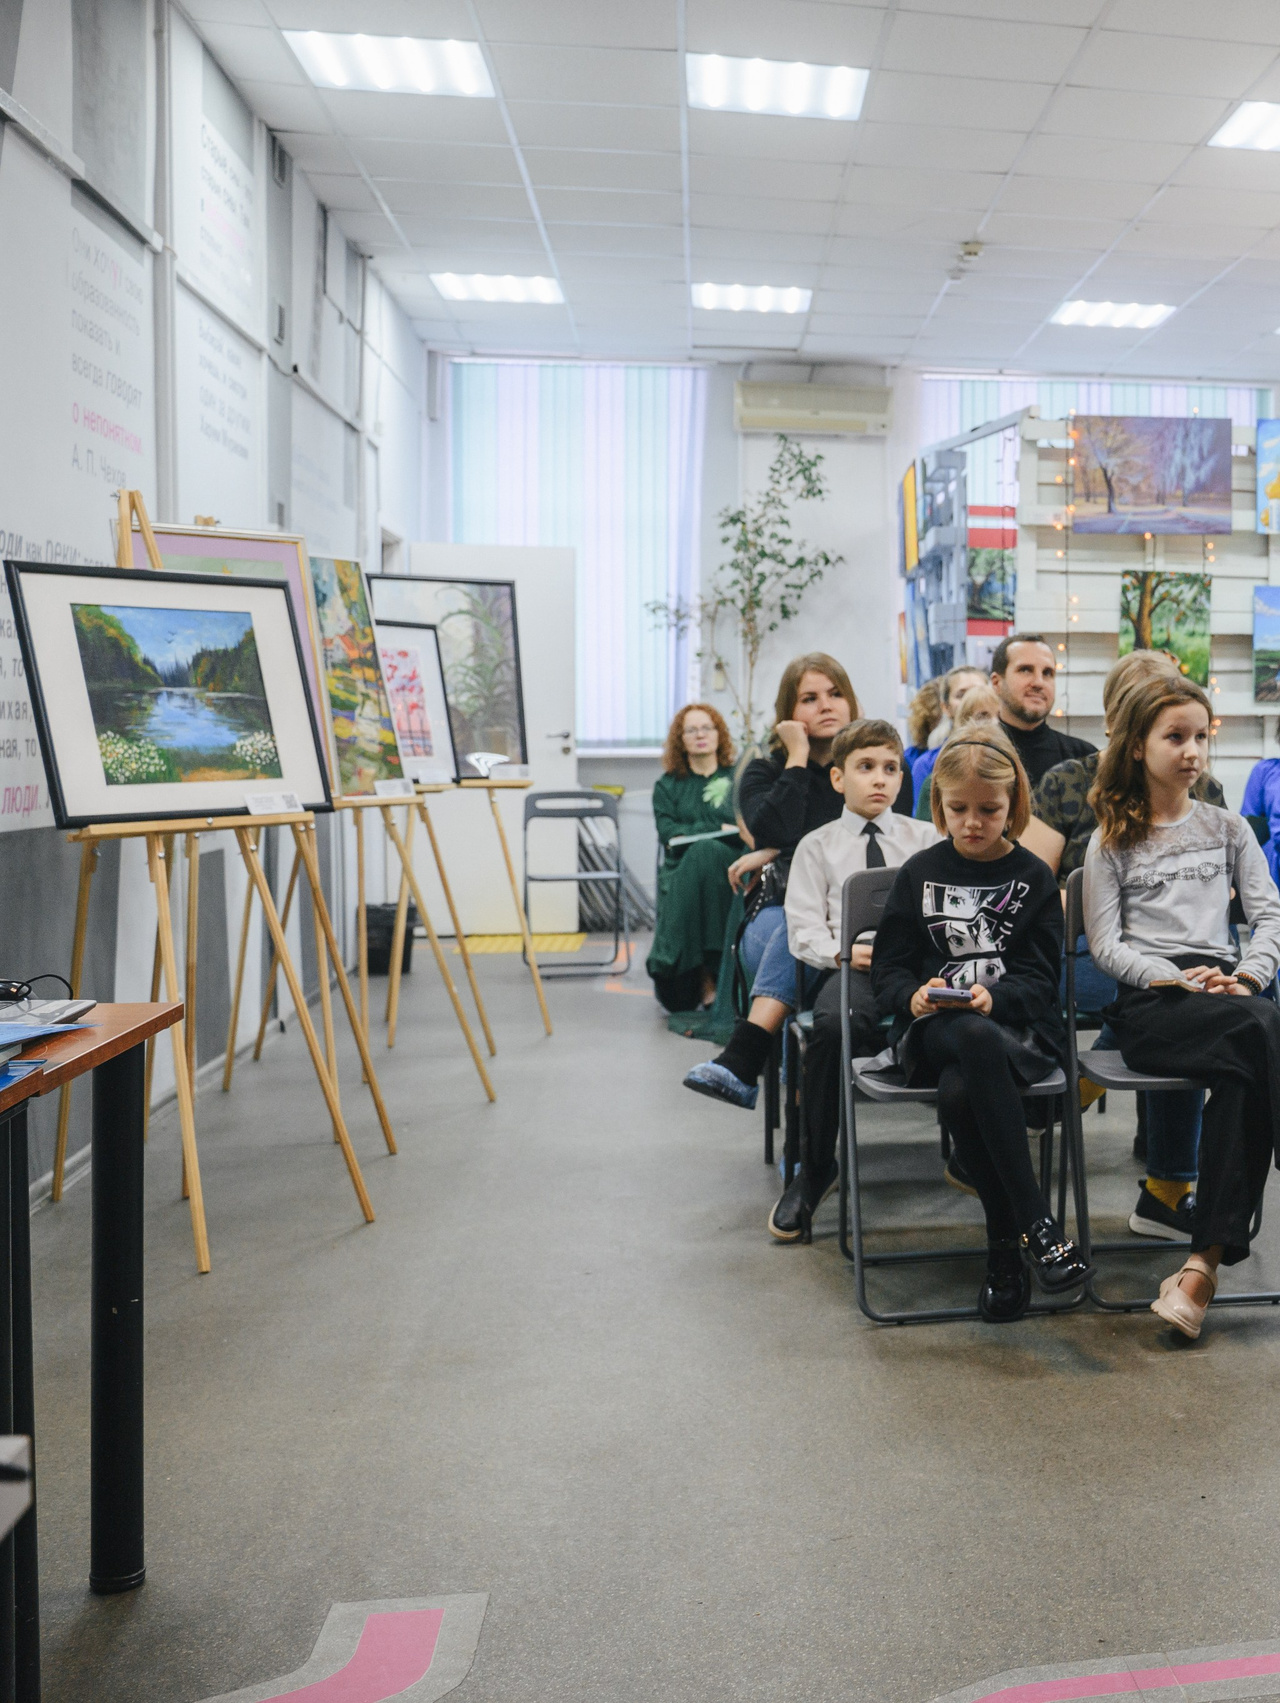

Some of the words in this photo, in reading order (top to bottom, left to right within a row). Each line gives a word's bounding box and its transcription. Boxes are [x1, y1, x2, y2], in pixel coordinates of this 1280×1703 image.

[72, 352, 102, 387] всегда
[107, 369, 142, 410] говорят
[26, 738, 37, 757] то
